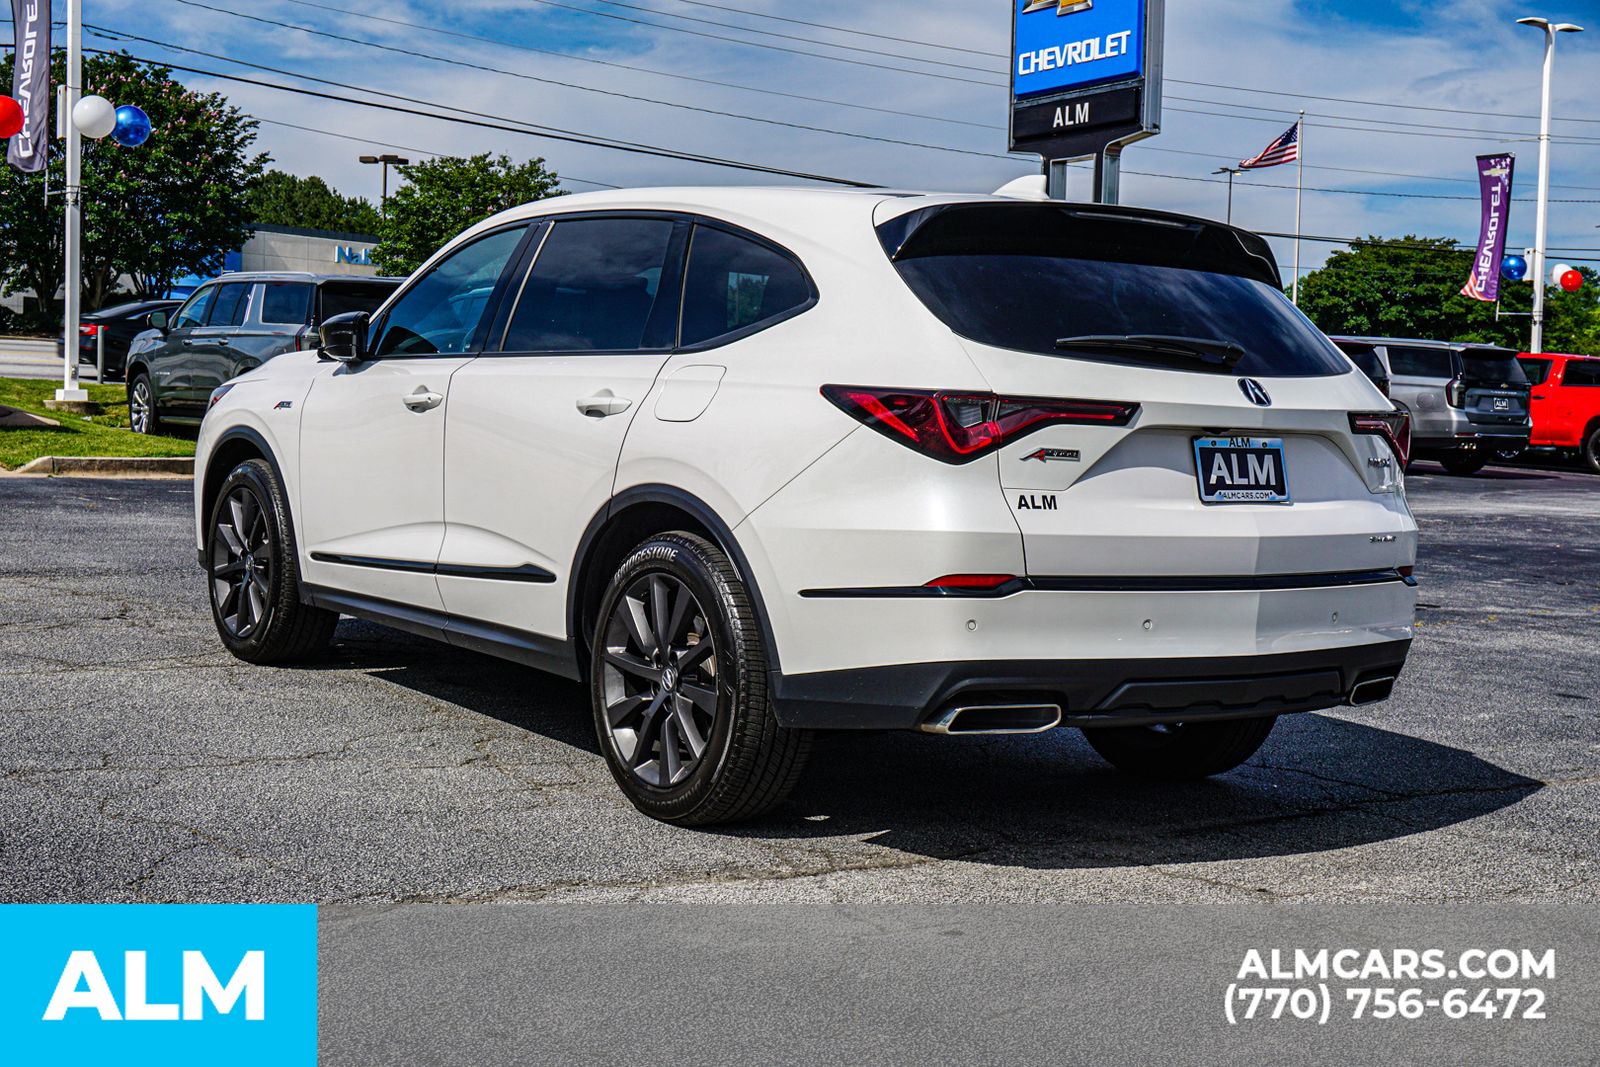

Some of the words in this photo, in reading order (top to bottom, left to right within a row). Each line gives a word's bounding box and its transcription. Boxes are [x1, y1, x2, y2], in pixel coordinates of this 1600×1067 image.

[1018, 30, 1131, 76] CHEVROLET
[1053, 102, 1090, 128] ALM
[1229, 438, 1251, 448] ALM
[1209, 453, 1276, 485] ALM
[1018, 495, 1058, 510] ALM
[1222, 491, 1270, 500] ALMCARS.COM
